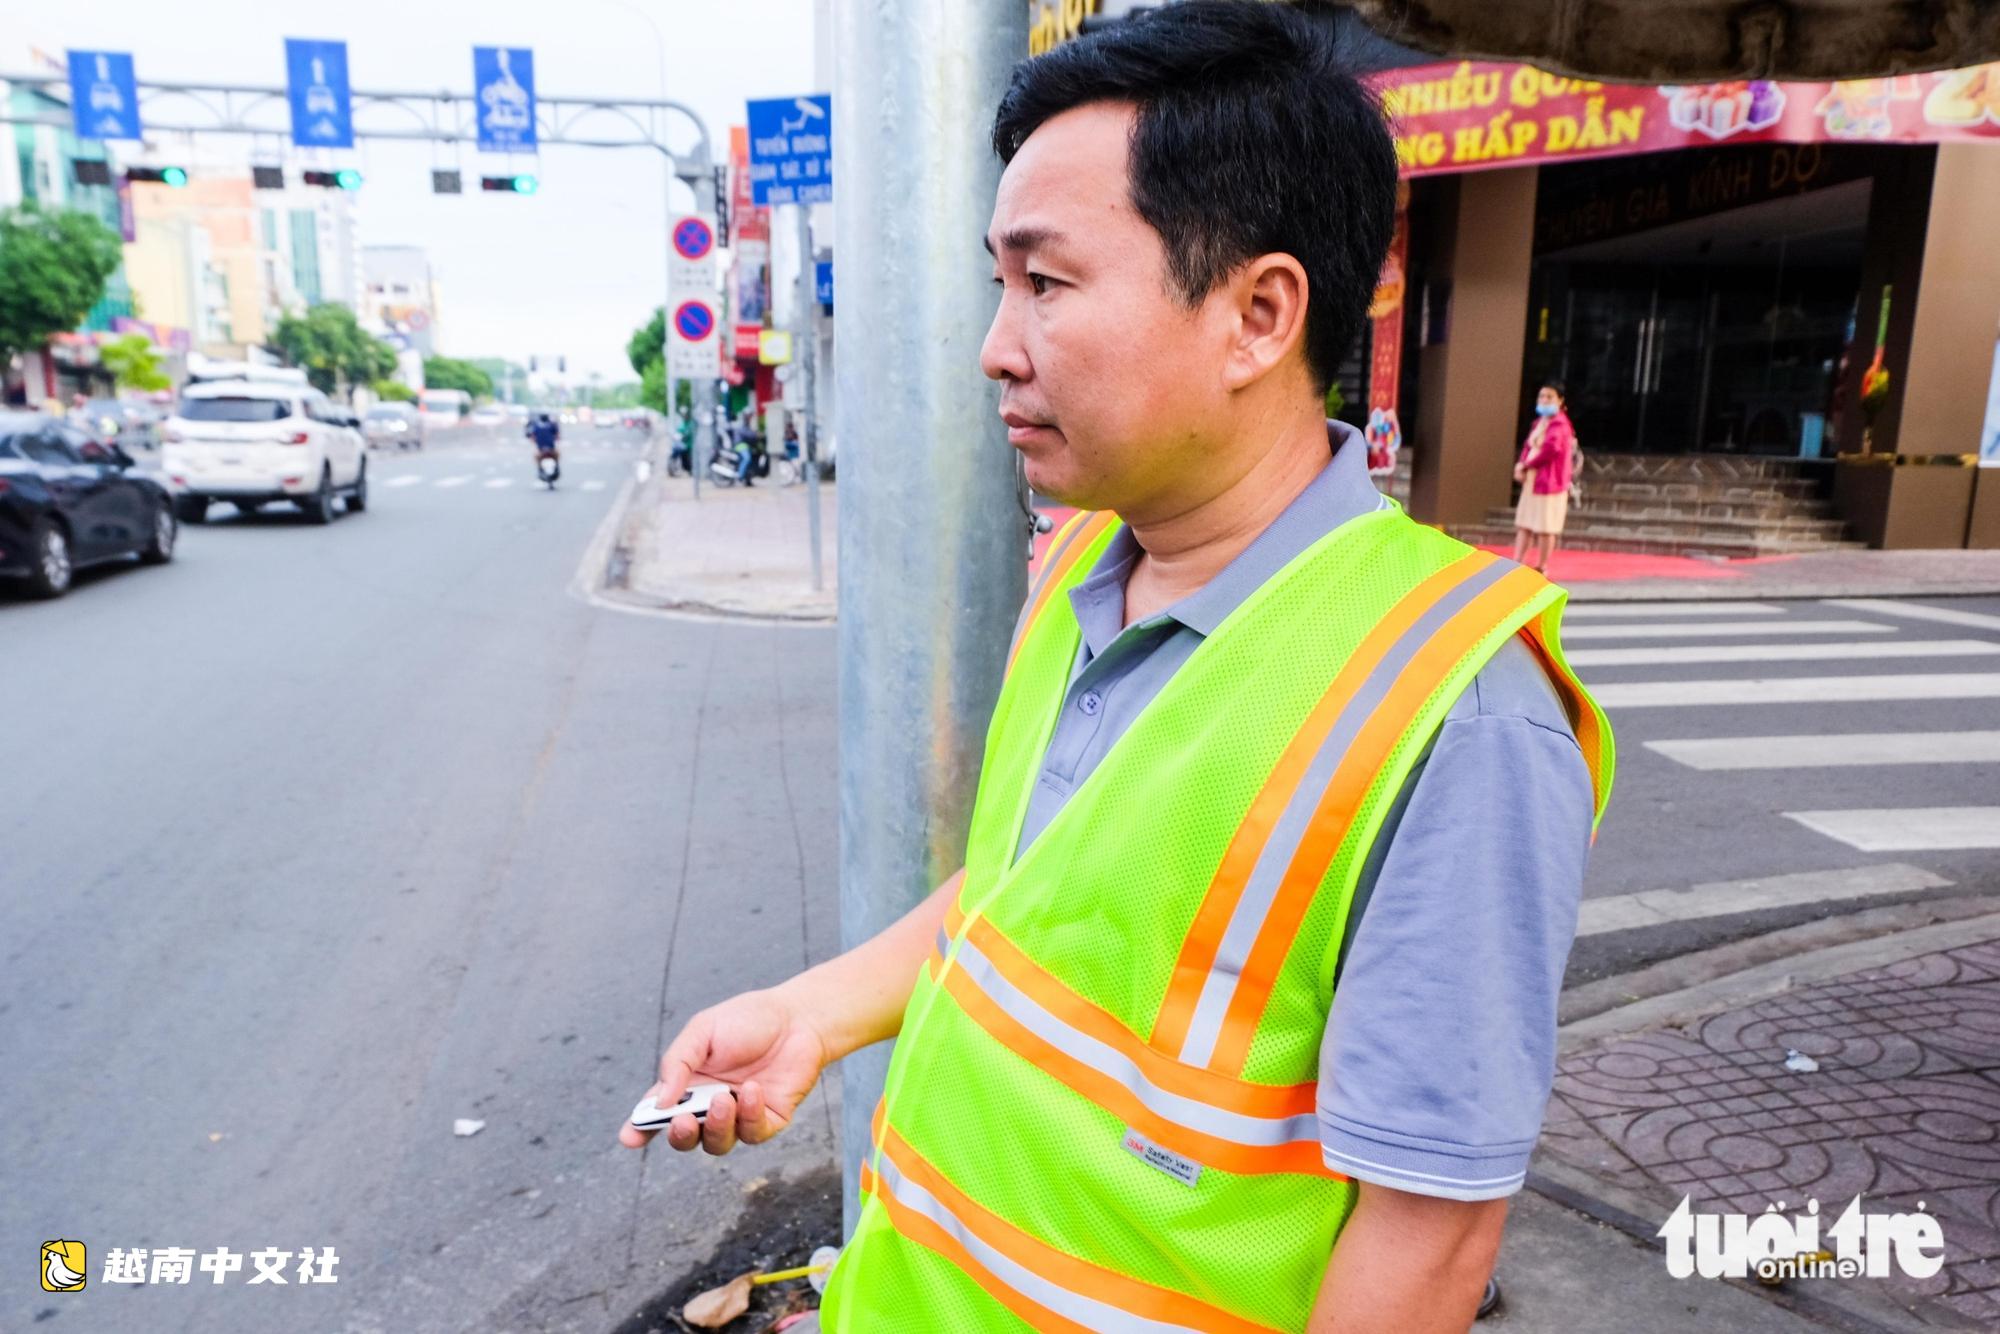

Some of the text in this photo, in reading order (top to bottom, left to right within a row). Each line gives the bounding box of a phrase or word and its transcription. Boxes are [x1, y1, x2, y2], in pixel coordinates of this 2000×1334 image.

[1509, 64, 1604, 108] QU
[1452, 109, 1539, 163] HẤP
[1545, 94, 1645, 153] DẪN
